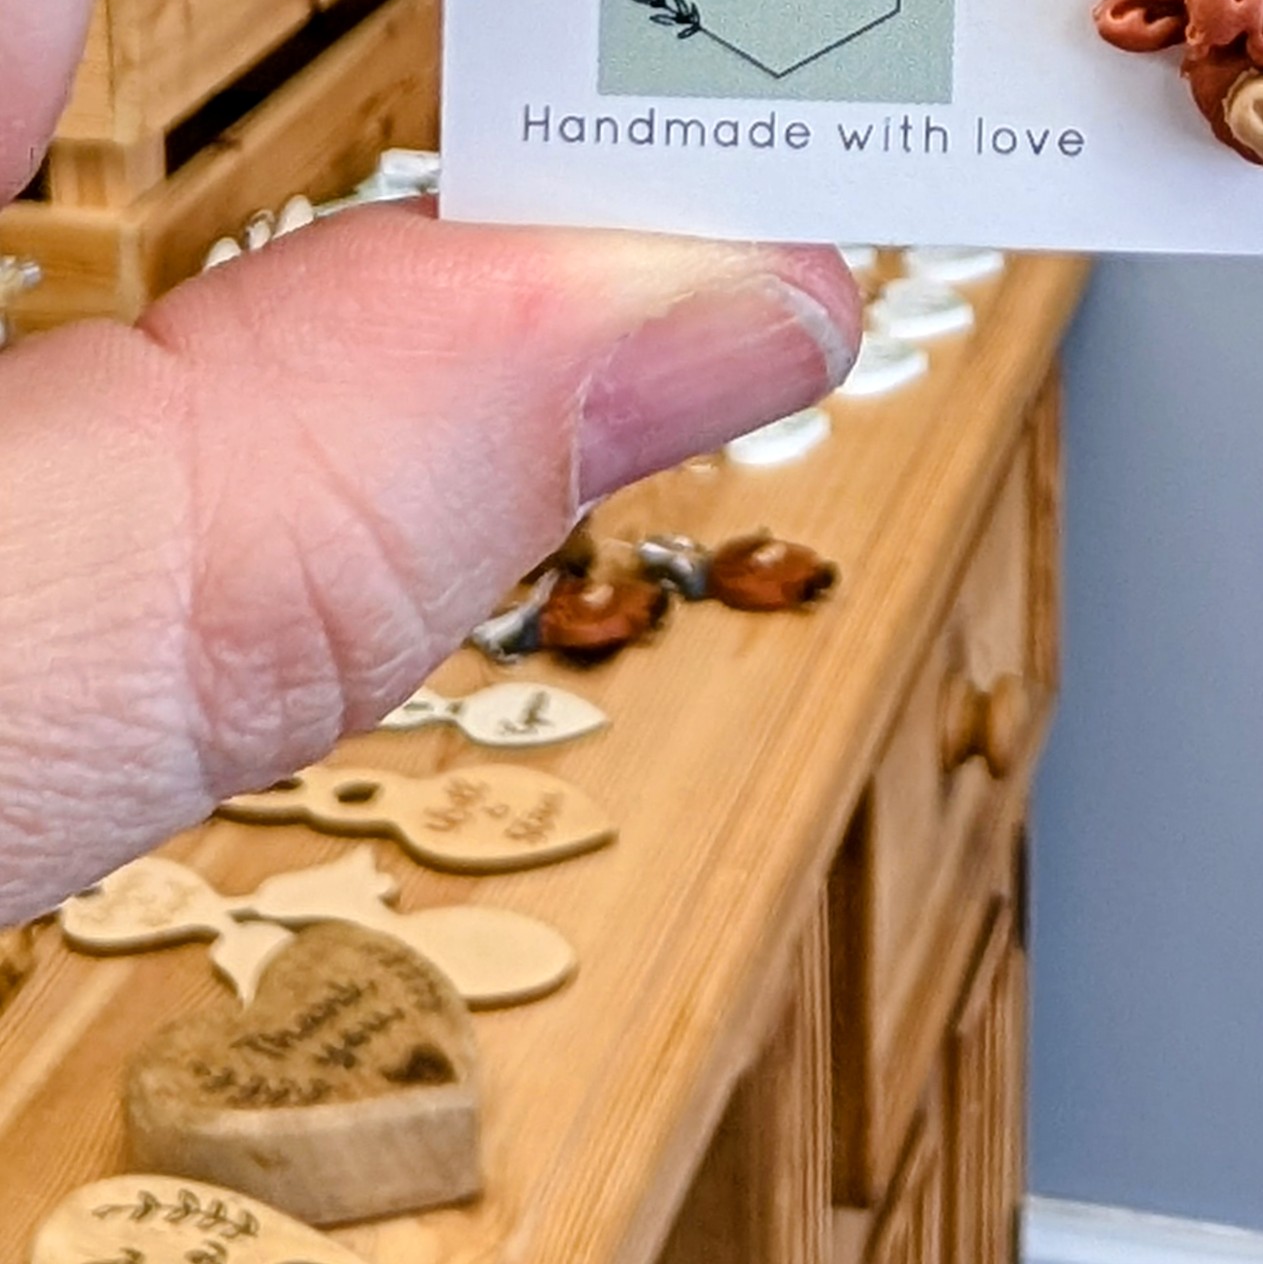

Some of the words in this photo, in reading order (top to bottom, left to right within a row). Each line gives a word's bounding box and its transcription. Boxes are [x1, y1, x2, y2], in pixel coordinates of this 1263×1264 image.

[522, 103, 812, 150] Handmade
[837, 115, 949, 154] with
[977, 116, 1086, 157] love
